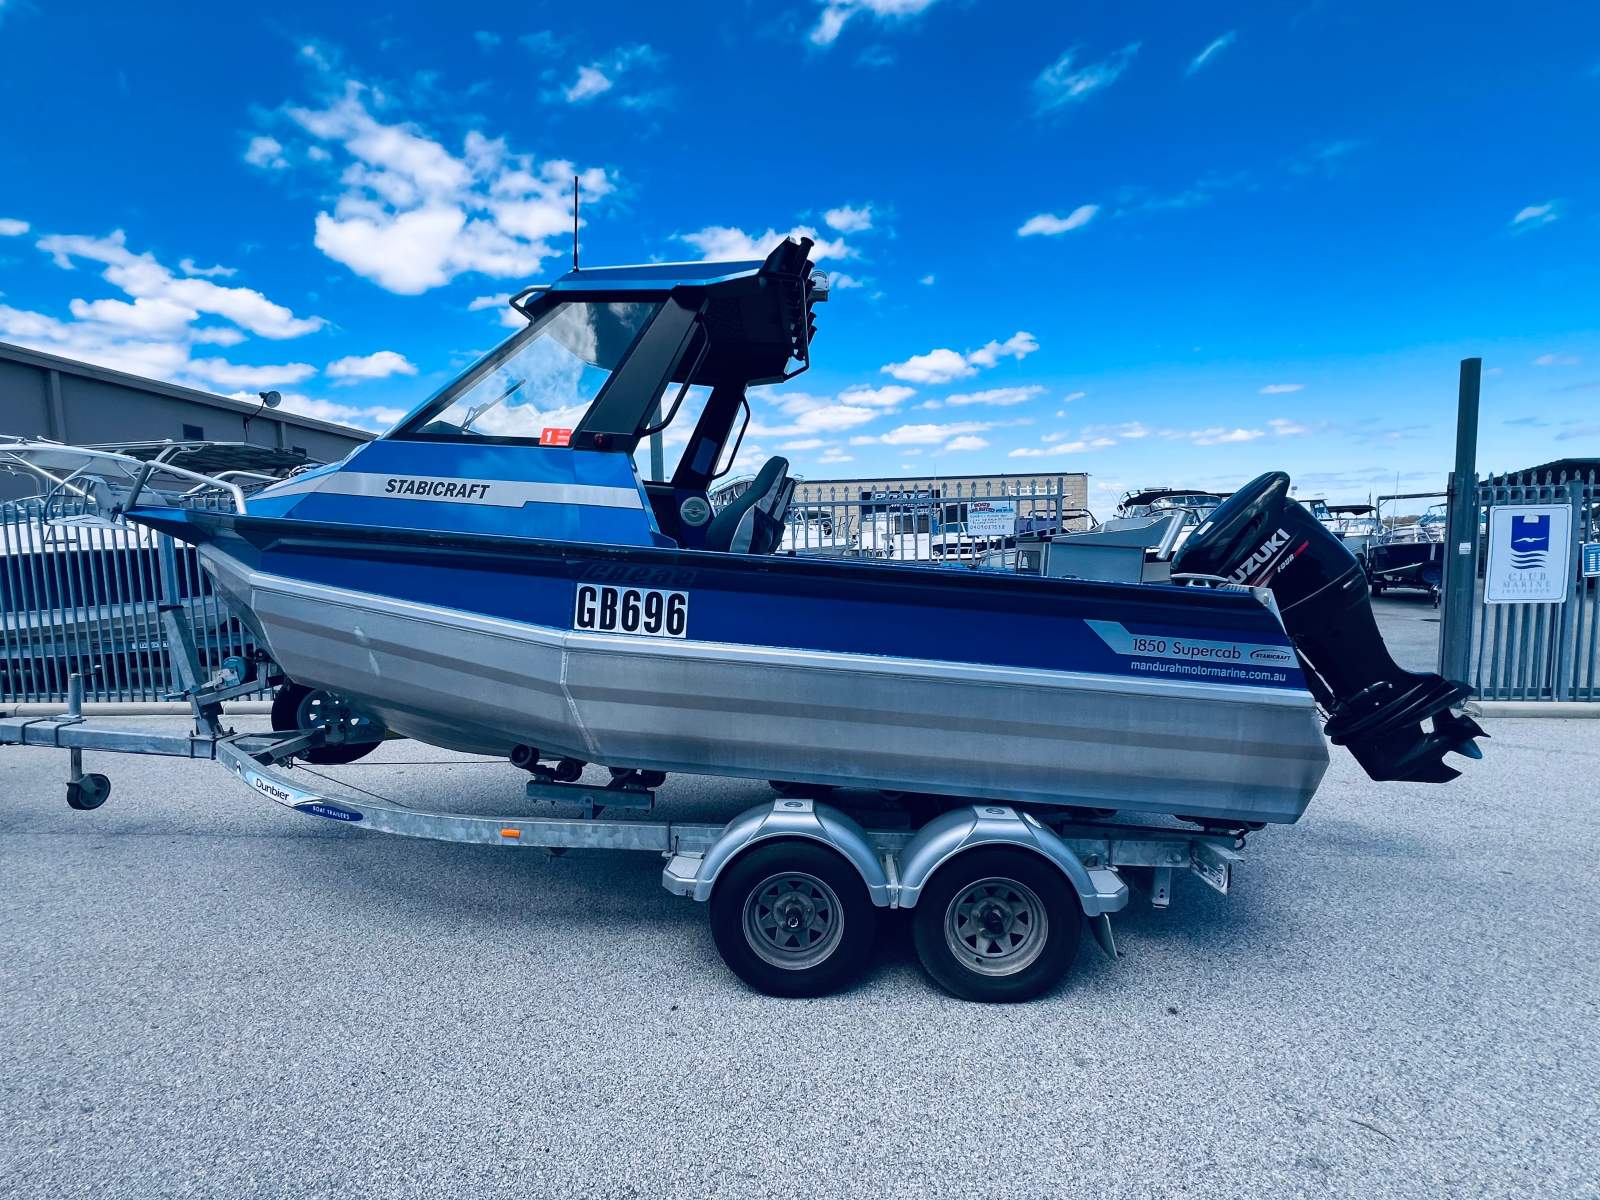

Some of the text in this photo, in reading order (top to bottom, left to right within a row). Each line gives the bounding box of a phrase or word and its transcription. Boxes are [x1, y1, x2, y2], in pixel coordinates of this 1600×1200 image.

[384, 478, 490, 499] STABICRAFT
[1508, 572, 1546, 581] CLUB
[576, 585, 686, 635] GB696
[1132, 638, 1166, 654] 1850
[1172, 641, 1241, 659] Supercab
[1130, 660, 1287, 682] mandurahmotormarine.com.au
[255, 778, 290, 801] Dunbier
[312, 805, 350, 820] BOAT TRAILERS
